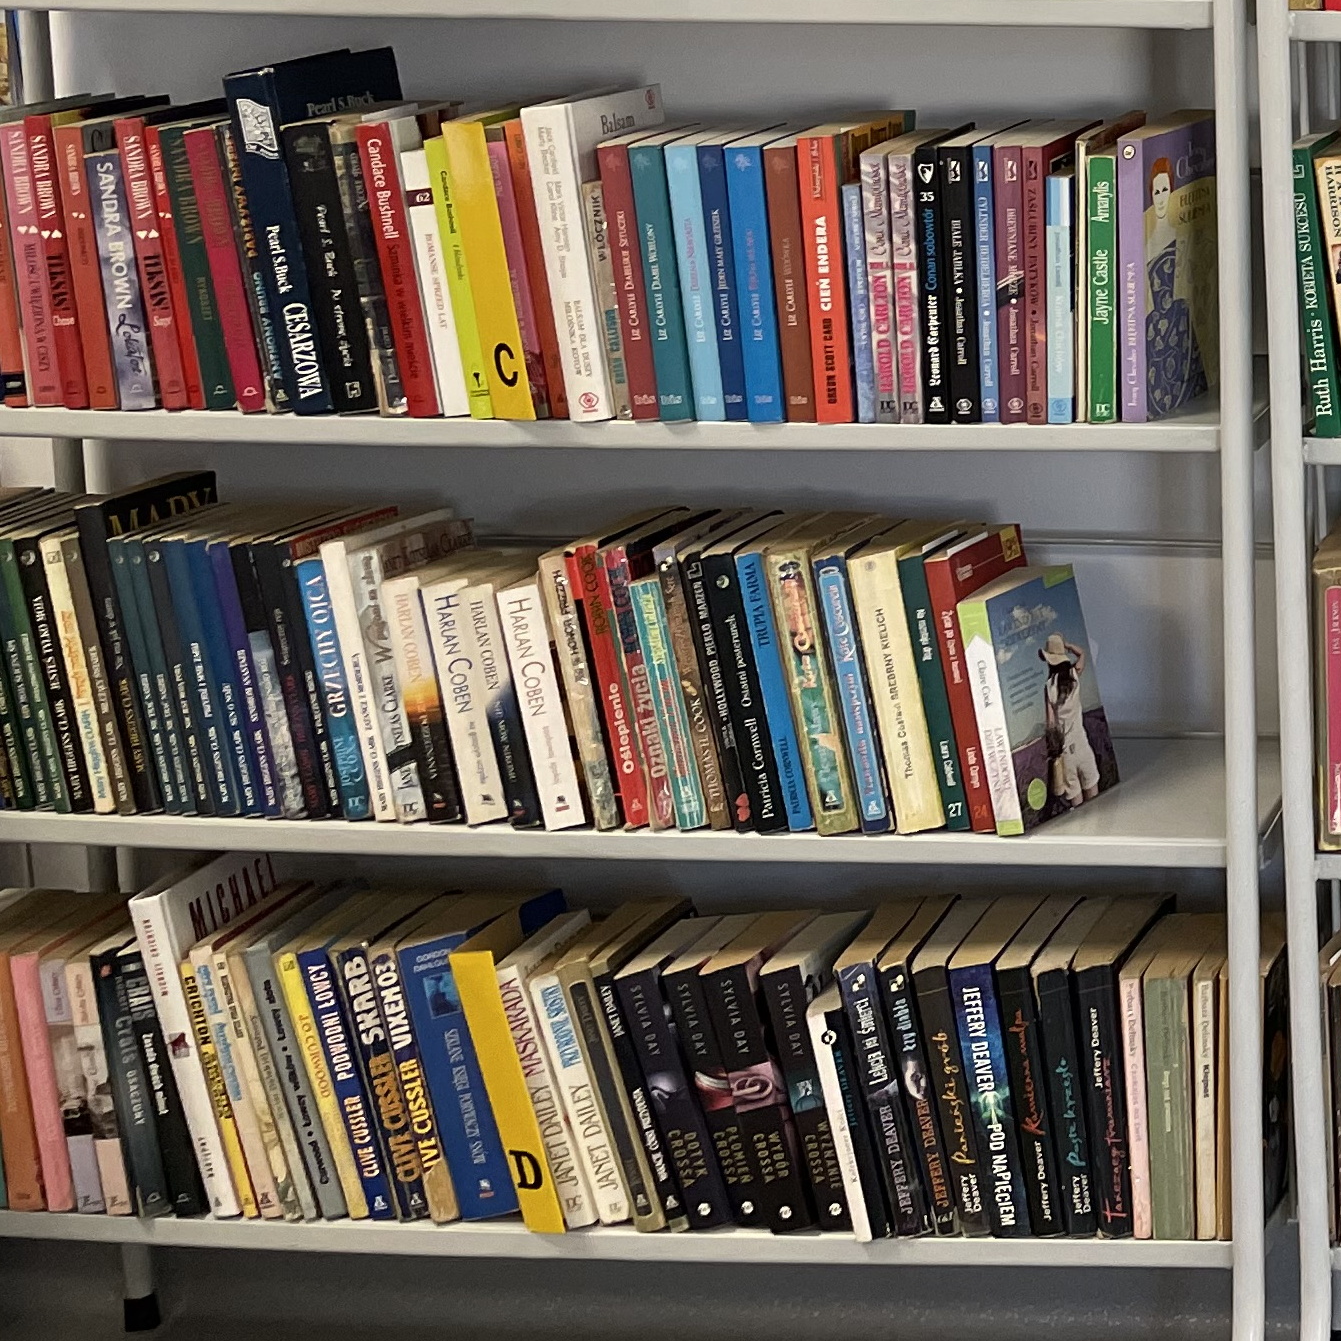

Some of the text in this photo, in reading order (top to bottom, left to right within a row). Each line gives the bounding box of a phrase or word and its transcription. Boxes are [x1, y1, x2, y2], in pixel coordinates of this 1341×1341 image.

[368, 138, 400, 240] Candace Bushnell
[96, 161, 131, 310] SANDRA BROWN
[814, 215, 831, 310] CIEŃ ENDERA
[1092, 248, 1109, 324] Jayne Castle
[1305, 255, 1318, 308] KOBIETA
[282, 302, 318, 398] CESARZOWA
[494, 342, 518, 388] C
[1311, 322, 1327, 374] Harris
[1315, 378, 1332, 416] Ruth
[435, 594, 472, 713] HARLAN COBEN
[745, 717, 773, 820] Patricia Cornwell
[948, 801, 962, 818] 27
[345, 957, 380, 1046] SKARB
[510, 1151, 541, 1188] D
[988, 1124, 1005, 1152] POD
